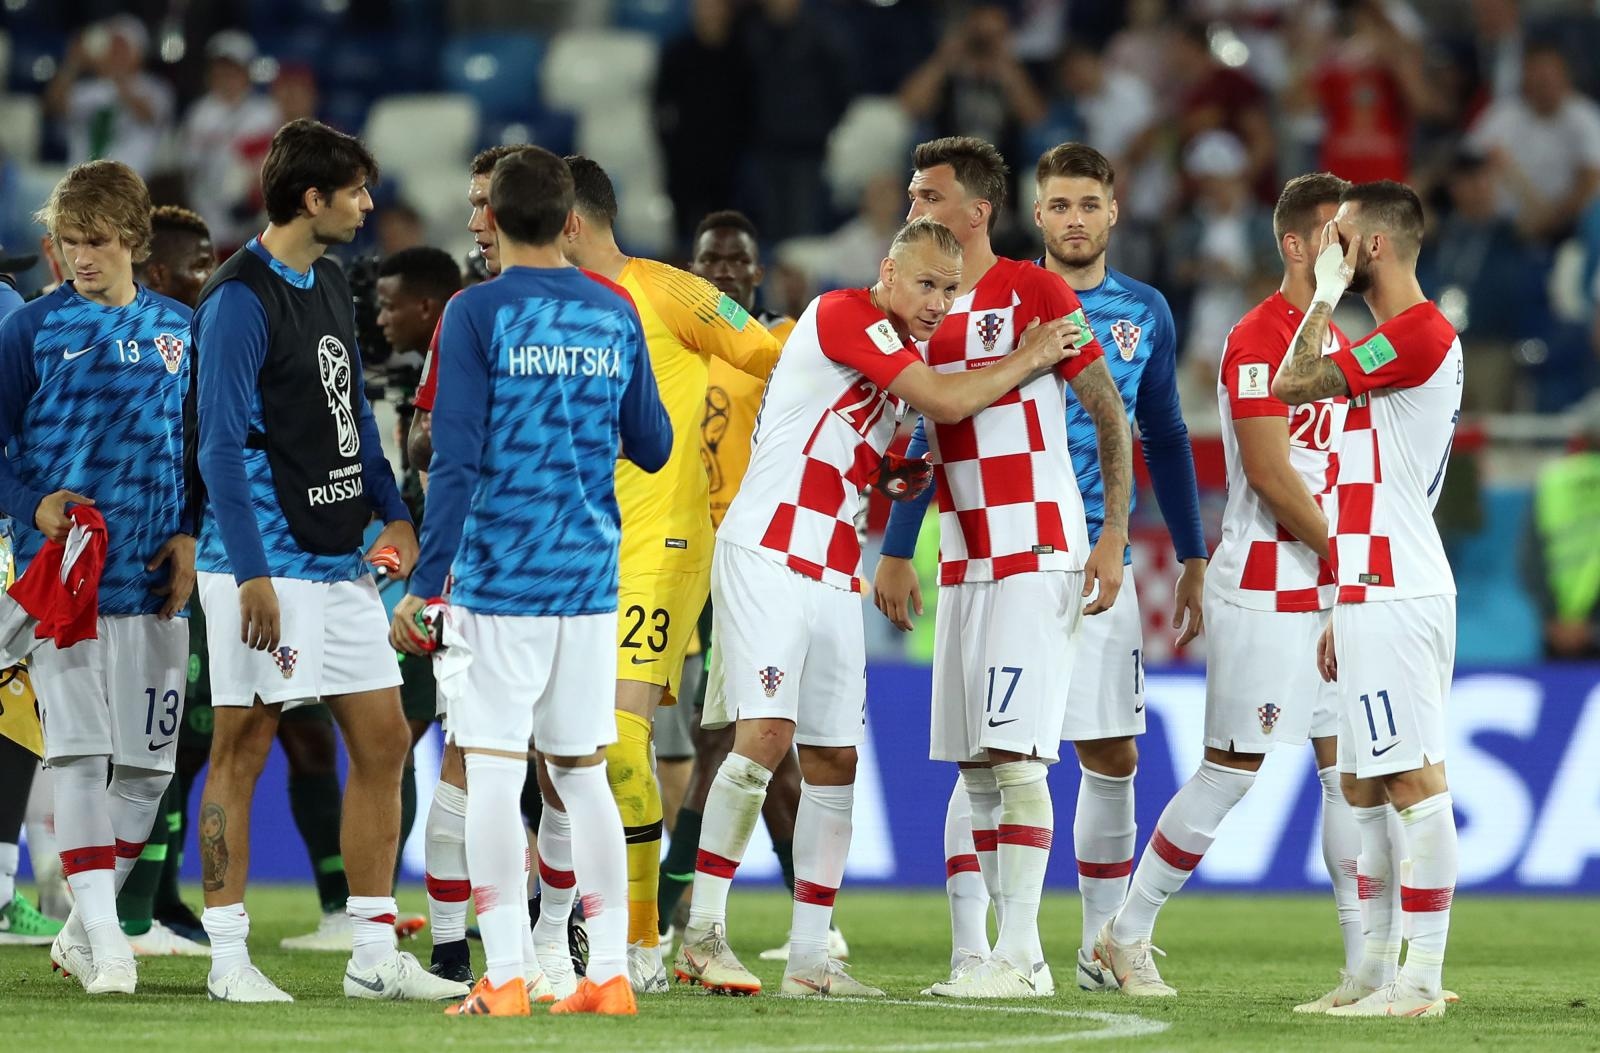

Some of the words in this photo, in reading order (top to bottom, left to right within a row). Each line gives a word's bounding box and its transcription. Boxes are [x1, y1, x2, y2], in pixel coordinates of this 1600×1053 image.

[116, 339, 141, 364] 13
[508, 345, 620, 378] HRVATSKA
[836, 381, 888, 435] 21
[1289, 402, 1334, 450] 20
[307, 476, 364, 507] RUSSIA
[328, 468, 345, 481] FIFA
[620, 604, 671, 653] 23
[144, 687, 180, 737] 13
[986, 666, 1024, 714] 17
[1359, 689, 1397, 742] 11
[1144, 673, 1600, 886] VS
